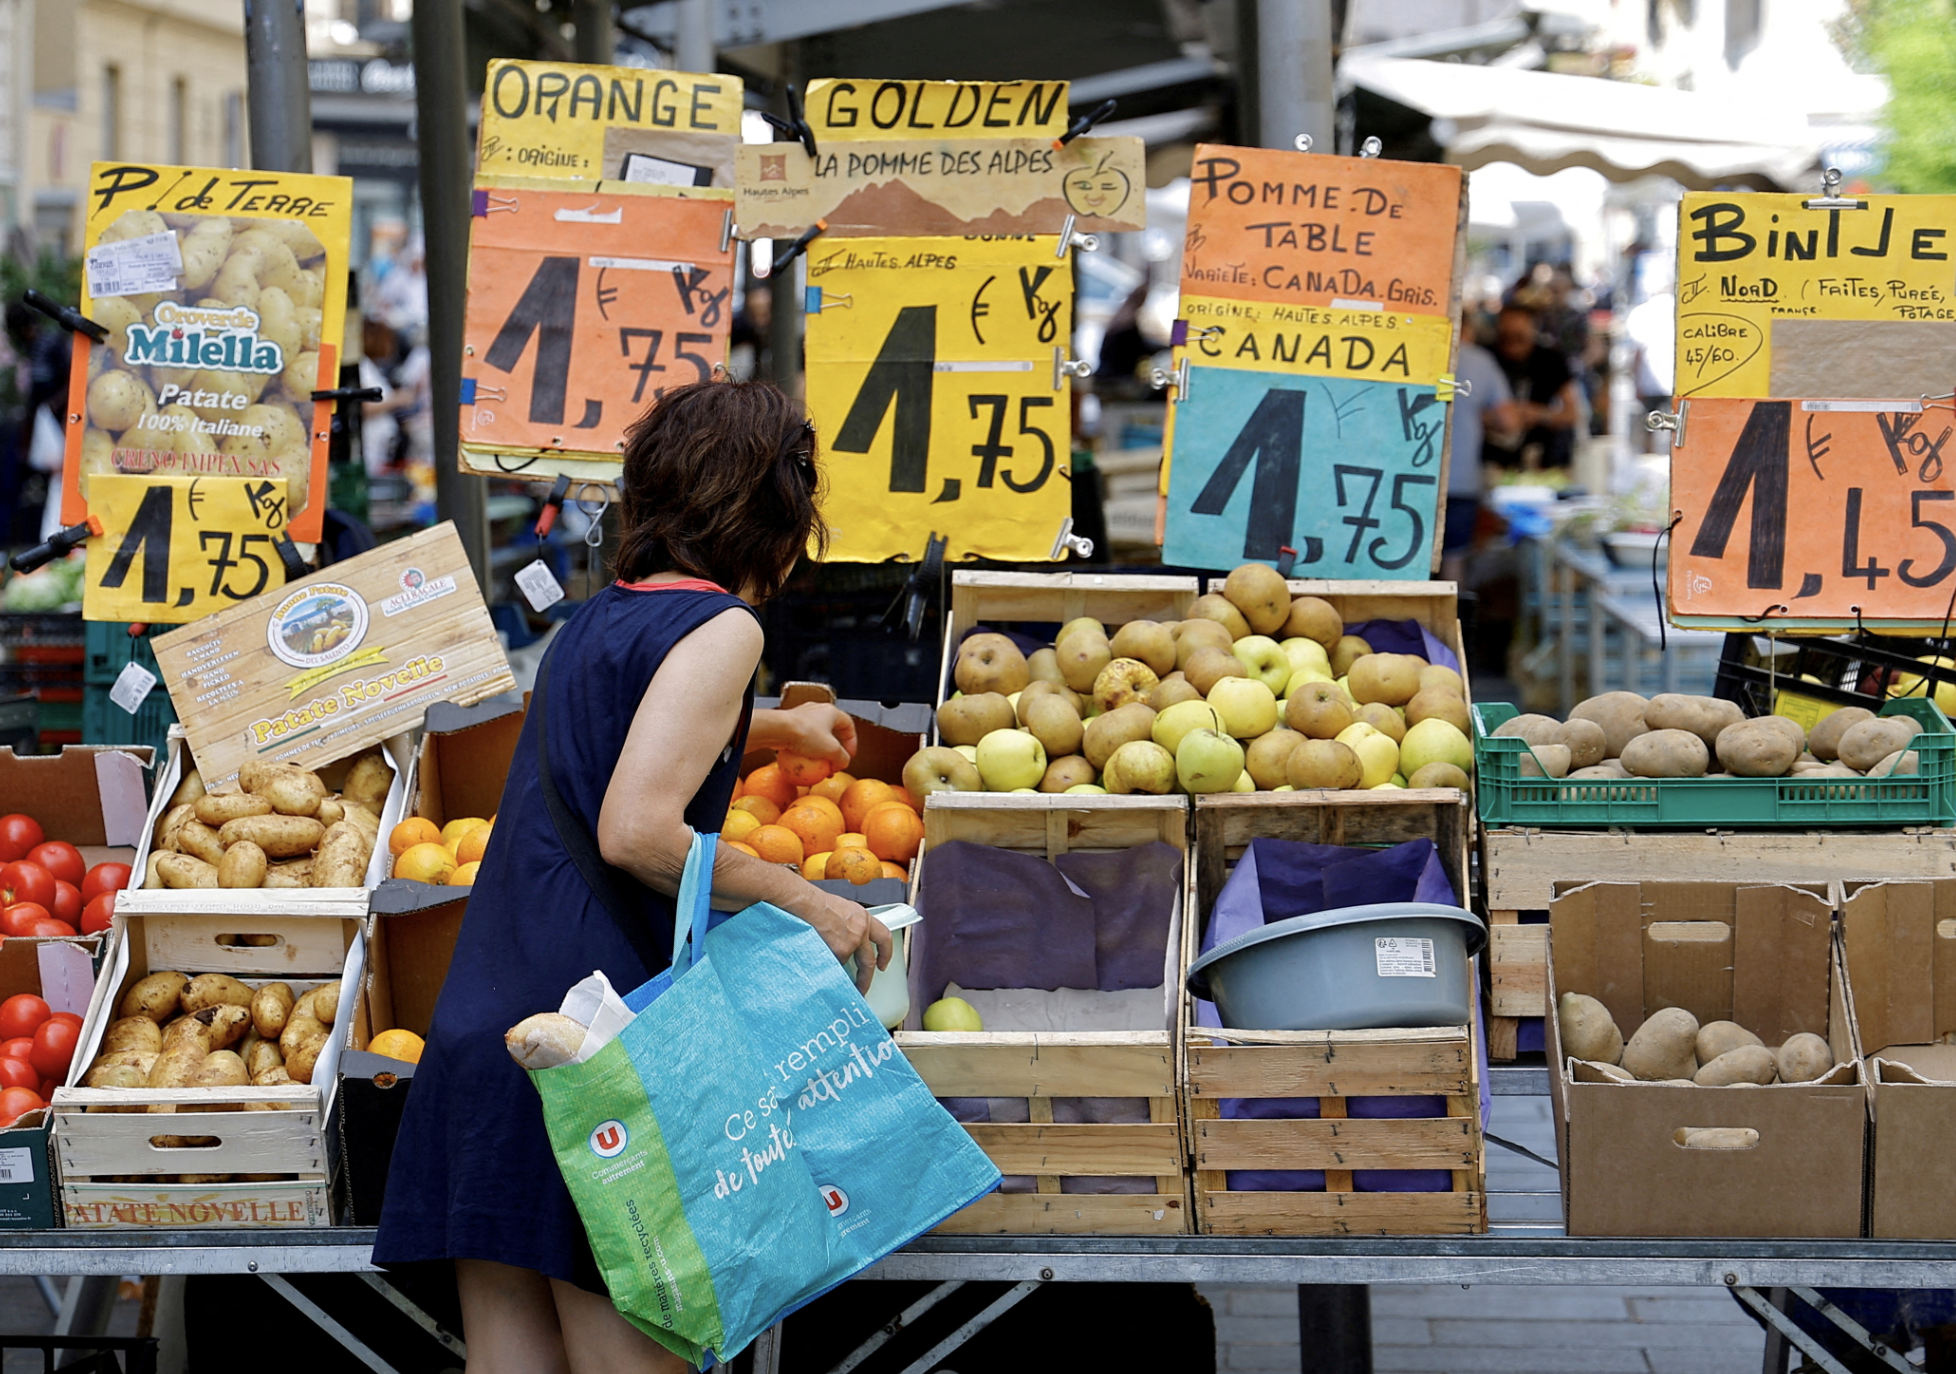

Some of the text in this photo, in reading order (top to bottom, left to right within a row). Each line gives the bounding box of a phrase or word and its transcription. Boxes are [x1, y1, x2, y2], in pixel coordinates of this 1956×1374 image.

[492, 65, 722, 130] ORANGE
[826, 82, 1066, 129] GOLDEN
[814, 149, 1054, 178] LA POMME DES ALPES
[743, 186, 809, 197] Hautes Alpes
[1245, 221, 1376, 256] TABLE
[905, 254, 957, 270] ALPES
[672, 265, 730, 328] Kg
[1019, 266, 1062, 343] Kg
[158, 307, 256, 329] Oroverde
[127, 326, 279, 370] Milella
[1199, 326, 1411, 377] CANADA
[157, 383, 248, 410] Patate
[137, 414, 263, 437] 100% Italiane
[1397, 388, 1443, 467] Kg
[110, 447, 282, 477] CRENO IMPEX SAS
[1876, 412, 1953, 482] Kg
[244, 480, 285, 529] Kg
[274, 586, 348, 620] Buone Patate
[199, 647, 221, 659] MANO
[320, 643, 350, 662] SALENTO
[202, 667, 225, 680] HAND
[251, 698, 339, 743] Patate
[340, 656, 444, 707] Novelle
[725, 1110, 757, 1141] Ce
[774, 1001, 870, 1082] rempli
[596, 1126, 620, 1150] U
[591, 1150, 648, 1180] Commerçants
[602, 1159, 645, 1185] autrement
[714, 1168, 743, 1200] de
[163, 1201, 305, 1223] NOVELLE
[626, 1199, 653, 1261] recyclées
[649, 1263, 670, 1313] matières
